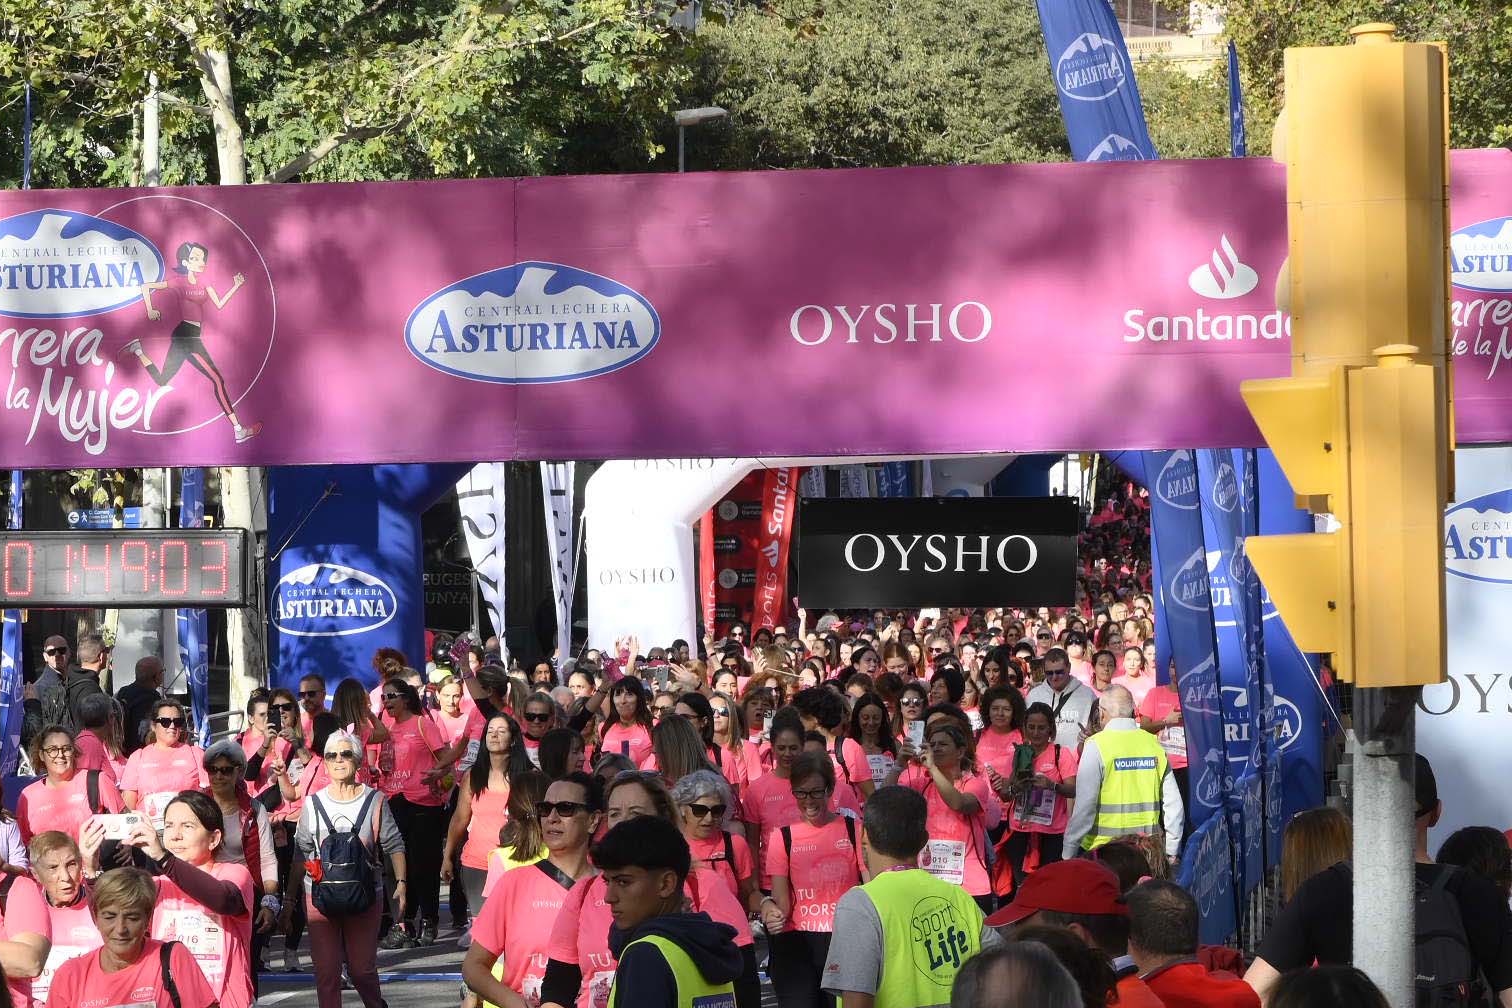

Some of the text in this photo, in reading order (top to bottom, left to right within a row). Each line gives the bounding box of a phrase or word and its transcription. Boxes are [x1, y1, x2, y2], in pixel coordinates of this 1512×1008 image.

[67, 244, 140, 257] LECHERA
[464, 302, 632, 317] CENTRAL LECHERA
[425, 309, 641, 354] ASTURIANA
[789, 301, 993, 346] OYSHO
[1123, 308, 1292, 342] Santand
[1474, 327, 1492, 356] la
[5, 369, 31, 410] la
[25, 360, 175, 456] Mujer
[843, 533, 1038, 574] OYSHO
[423, 573, 471, 586] EUGES
[599, 566, 675, 585] OYSHO
[287, 588, 329, 597] CENTRAL
[425, 592, 470, 605] UNYA
[761, 572, 778, 628] ports
[275, 593, 388, 620] ASTURIANA
[1416, 672, 1512, 716] OY
[1114, 759, 1156, 770] VOLUNTARIS
[797, 888, 814, 901] TU
[800, 902, 836, 917] DORS
[912, 902, 956, 943] Sport
[924, 925, 969, 971] Life
[528, 952, 548, 969] TU
[588, 952, 612, 969] TU
